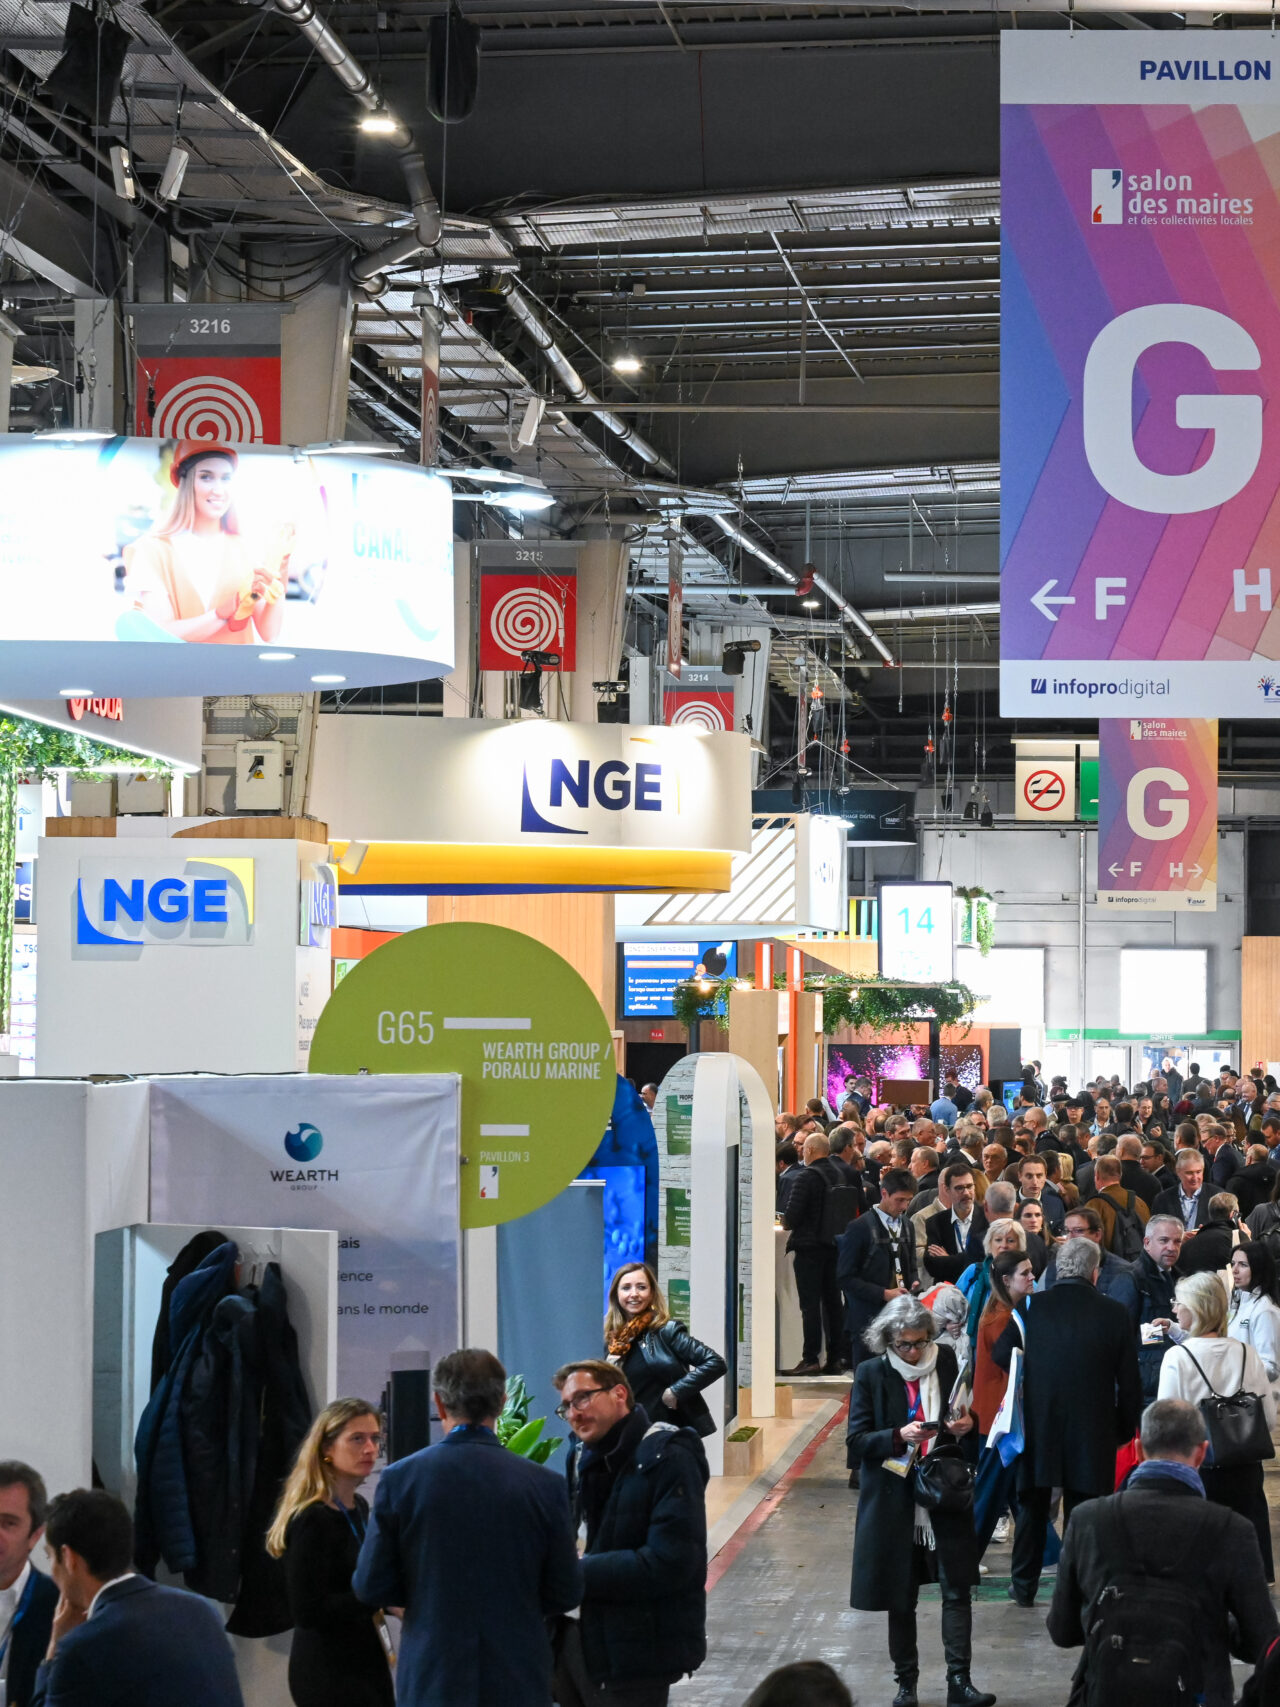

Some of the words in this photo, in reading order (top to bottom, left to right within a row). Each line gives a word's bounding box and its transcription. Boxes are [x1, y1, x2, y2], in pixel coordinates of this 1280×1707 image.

[1140, 60, 1271, 81] PAVILLON
[1128, 169, 1192, 191] salon
[1128, 192, 1168, 215] des
[1176, 193, 1254, 215] maires
[1128, 215, 1138, 225] et
[1140, 215, 1158, 225] des
[1161, 215, 1217, 225] collectivités
[1220, 215, 1254, 225] locales
[189, 318, 231, 334] 3216
[1083, 303, 1263, 514] G
[515, 550, 543, 561] 3215
[1095, 577, 1127, 620] F
[1233, 568, 1272, 612] H
[688, 674, 709, 682] 3214
[1053, 678, 1170, 698] infoprodigital
[1143, 729, 1157, 737] des
[1160, 729, 1187, 737] maires
[549, 758, 662, 811] NGE
[1126, 767, 1190, 840] G
[1130, 861, 1142, 877] F
[1169, 862, 1183, 878] H
[104, 878, 228, 923] NGE
[897, 906, 935, 934] 14
[377, 1011, 434, 1044] G65
[483, 1043, 543, 1060] WEARTH
[548, 1042, 600, 1060] GROUP
[482, 1062, 540, 1079] PORALU
[545, 1062, 601, 1079] MARINE
[480, 1151, 521, 1162] PAVILLON
[523, 1151, 530, 1162] 3
[270, 1170, 339, 1182] WEARTH
[364, 1302, 376, 1314] le
[379, 1302, 429, 1314] monde
